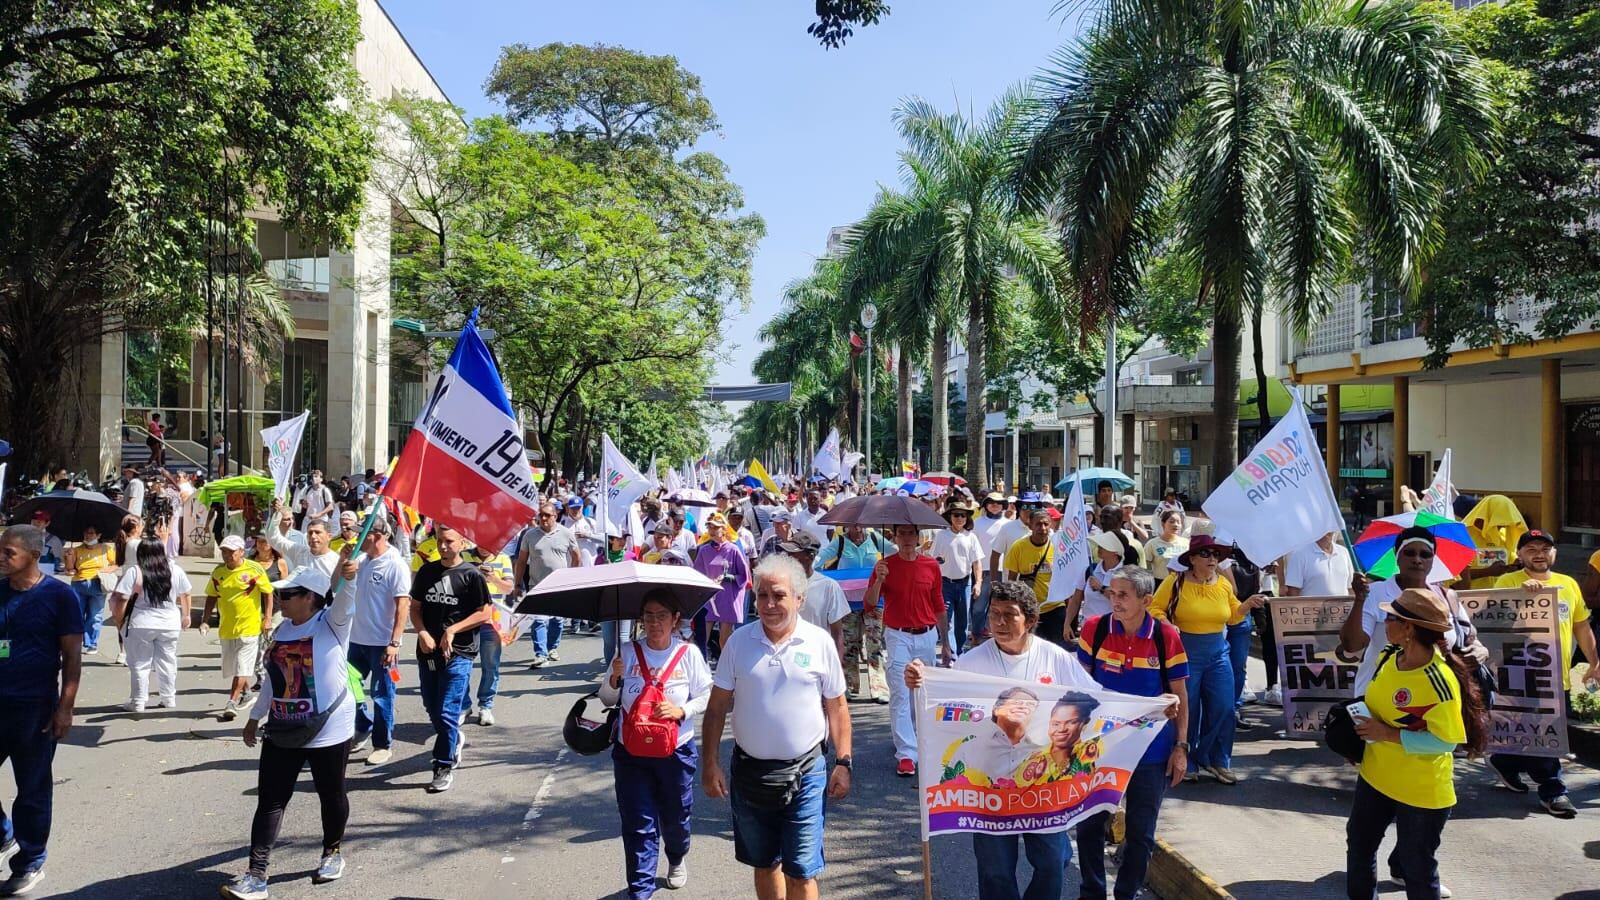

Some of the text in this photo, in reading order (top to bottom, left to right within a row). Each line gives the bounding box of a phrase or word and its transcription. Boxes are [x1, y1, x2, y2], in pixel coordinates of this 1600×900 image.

[475, 429, 524, 478] 19
[501, 472, 522, 489] DE
[425, 592, 459, 605] adidas
[1280, 605, 1351, 616] PRESIDE
[1487, 598, 1551, 609] PETRO
[1281, 611, 1549, 625] VICEPRES MARQUEZ
[1283, 644, 1326, 664] EL
[1503, 642, 1552, 668] ES
[935, 707, 985, 722] PETRO
[1496, 721, 1558, 736] MAYA
[1008, 789, 1049, 811] POR
[1056, 783, 1080, 805] LA
